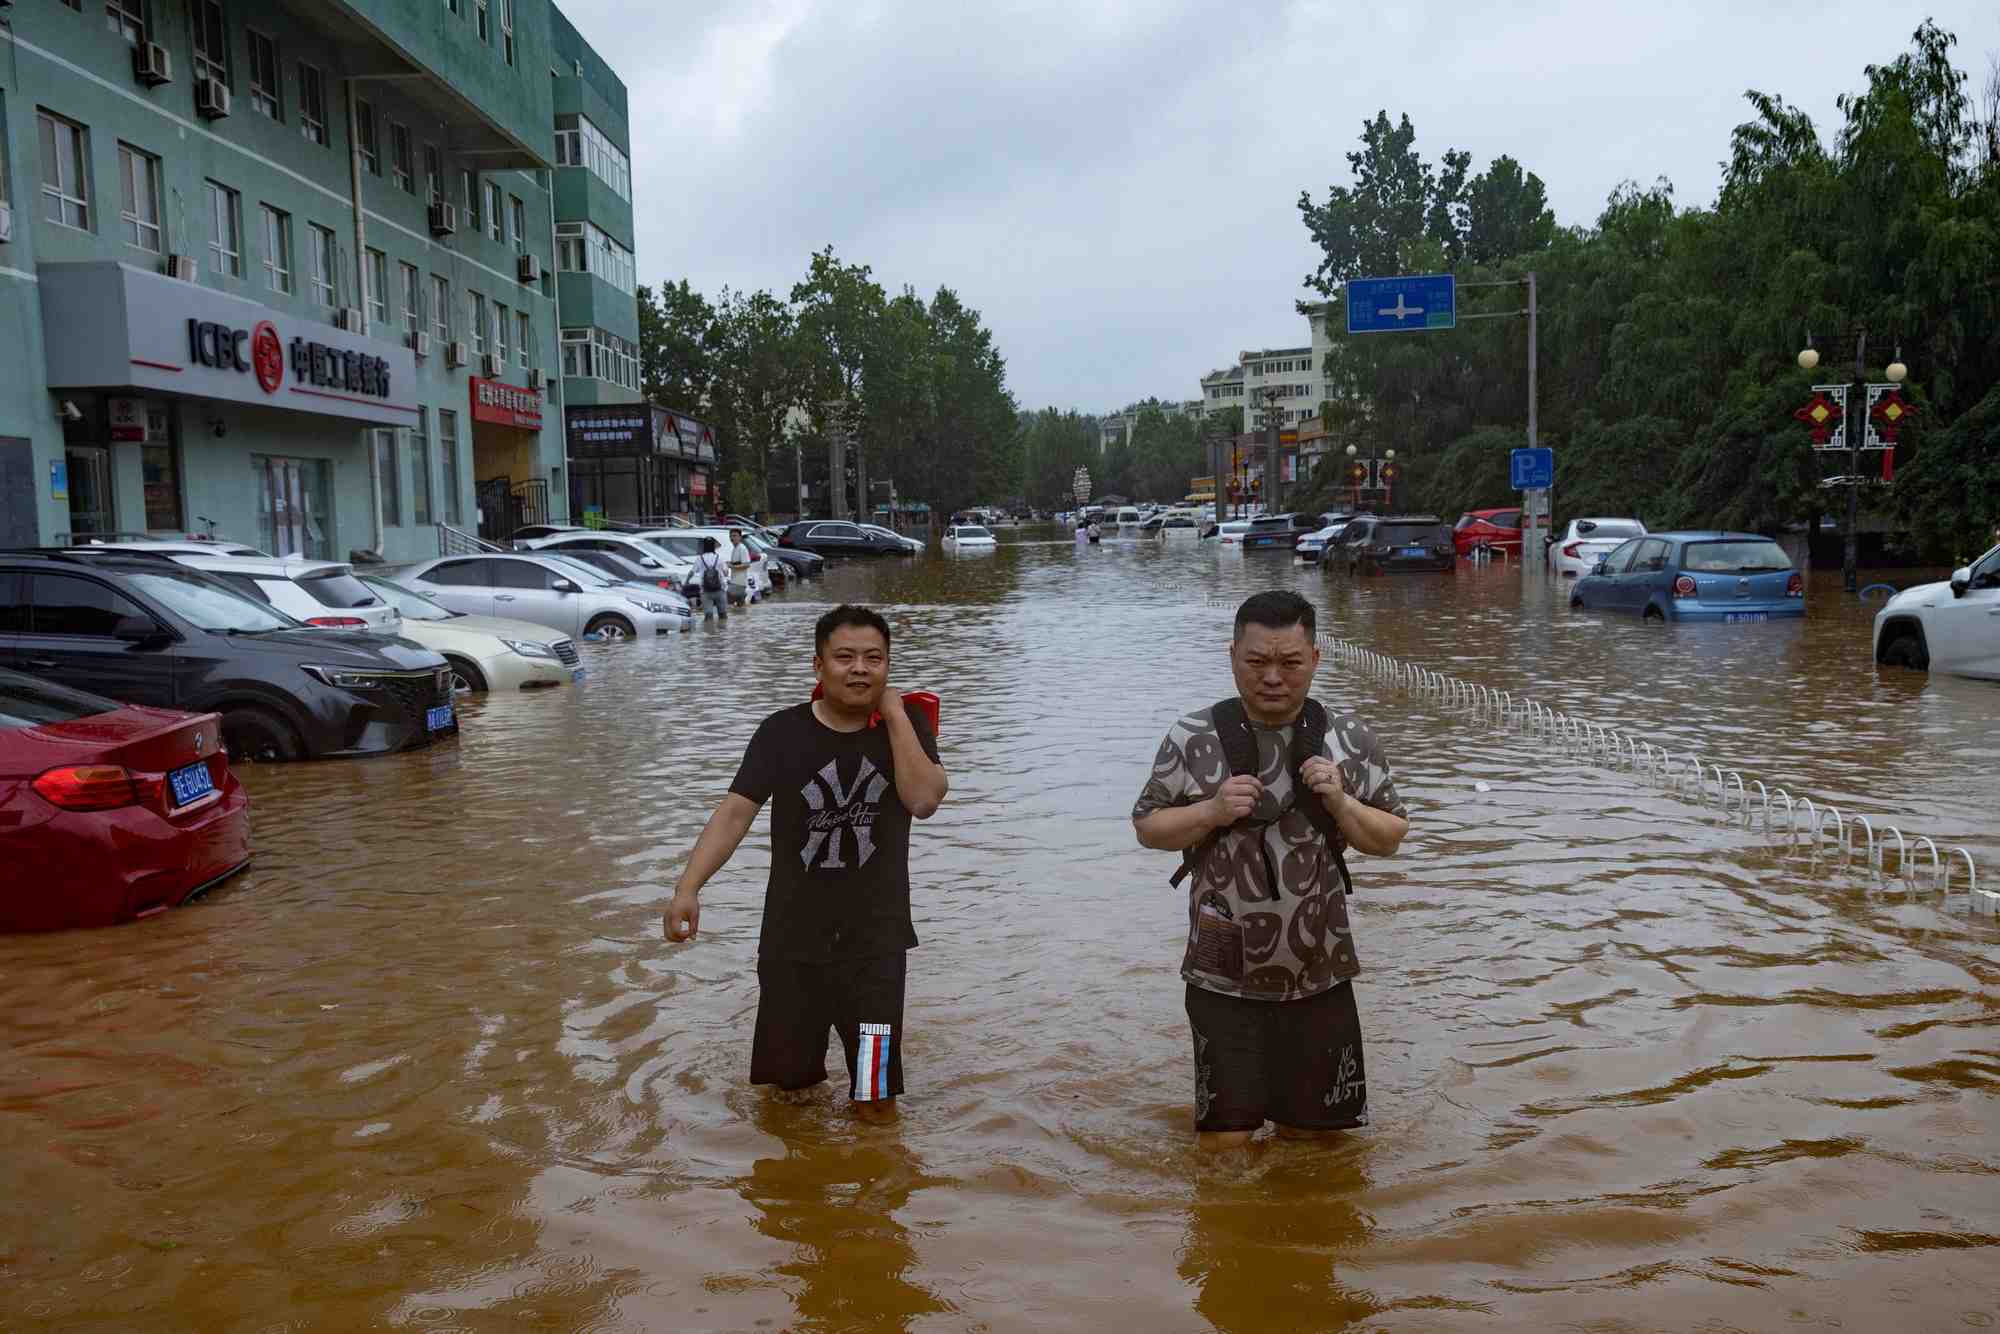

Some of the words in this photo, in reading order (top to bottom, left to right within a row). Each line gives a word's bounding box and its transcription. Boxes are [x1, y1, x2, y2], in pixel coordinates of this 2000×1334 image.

[186, 318, 250, 373] ICBC
[289, 336, 391, 399] 中国工商银行
[1516, 454, 1537, 485] P
[859, 1023, 891, 1035] PUMA
[1323, 1080, 1366, 1107] JUST
